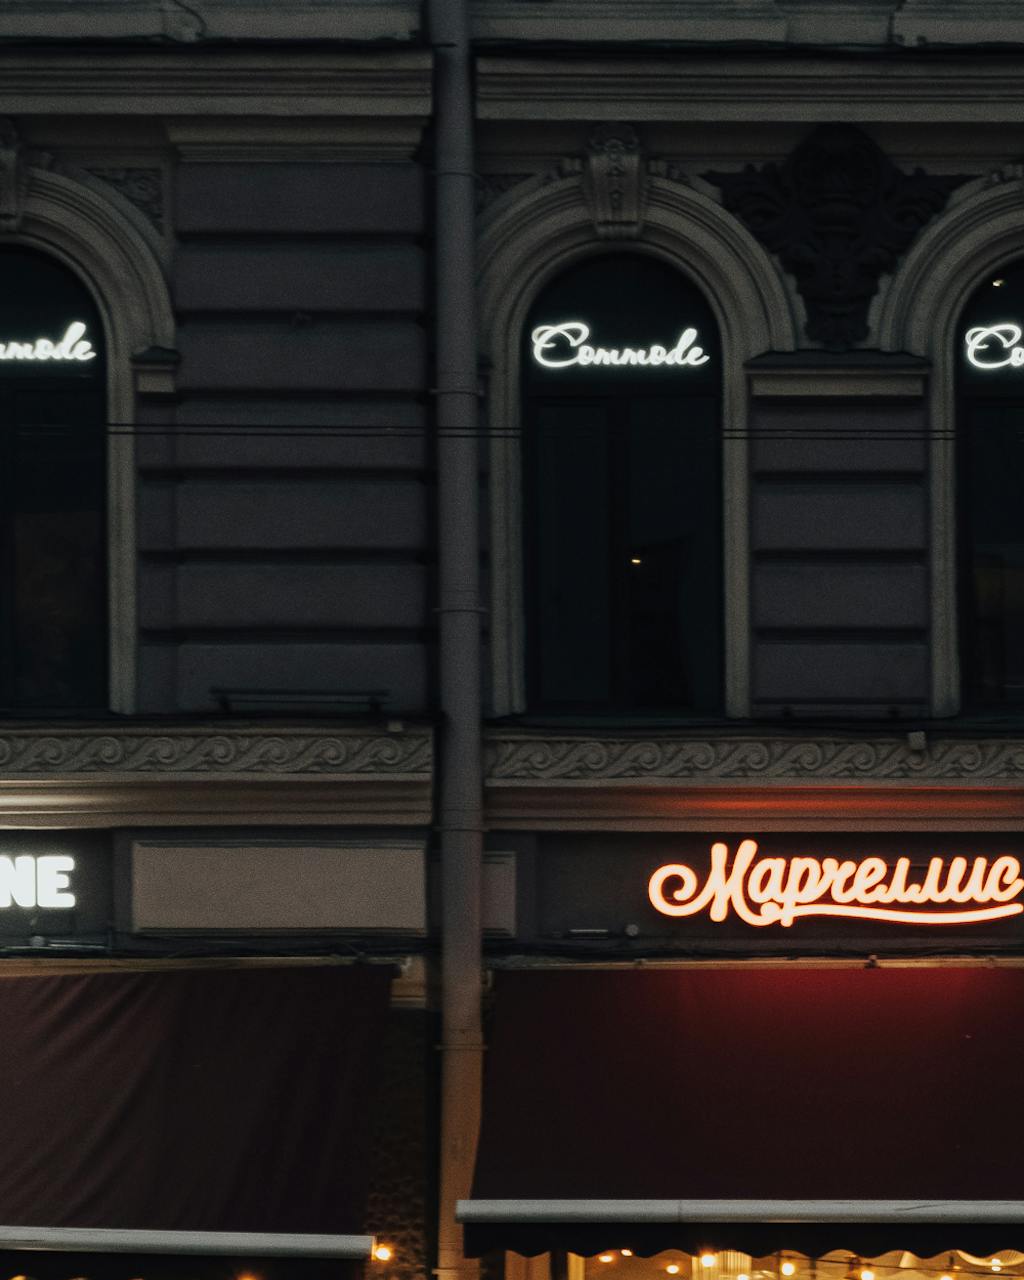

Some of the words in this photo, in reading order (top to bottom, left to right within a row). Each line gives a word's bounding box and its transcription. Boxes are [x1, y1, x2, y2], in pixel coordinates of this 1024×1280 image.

[0, 321, 97, 362] mode
[531, 321, 710, 368] Commode
[0, 854, 76, 909] NE
[648, 839, 1024, 927] Марчеллис
